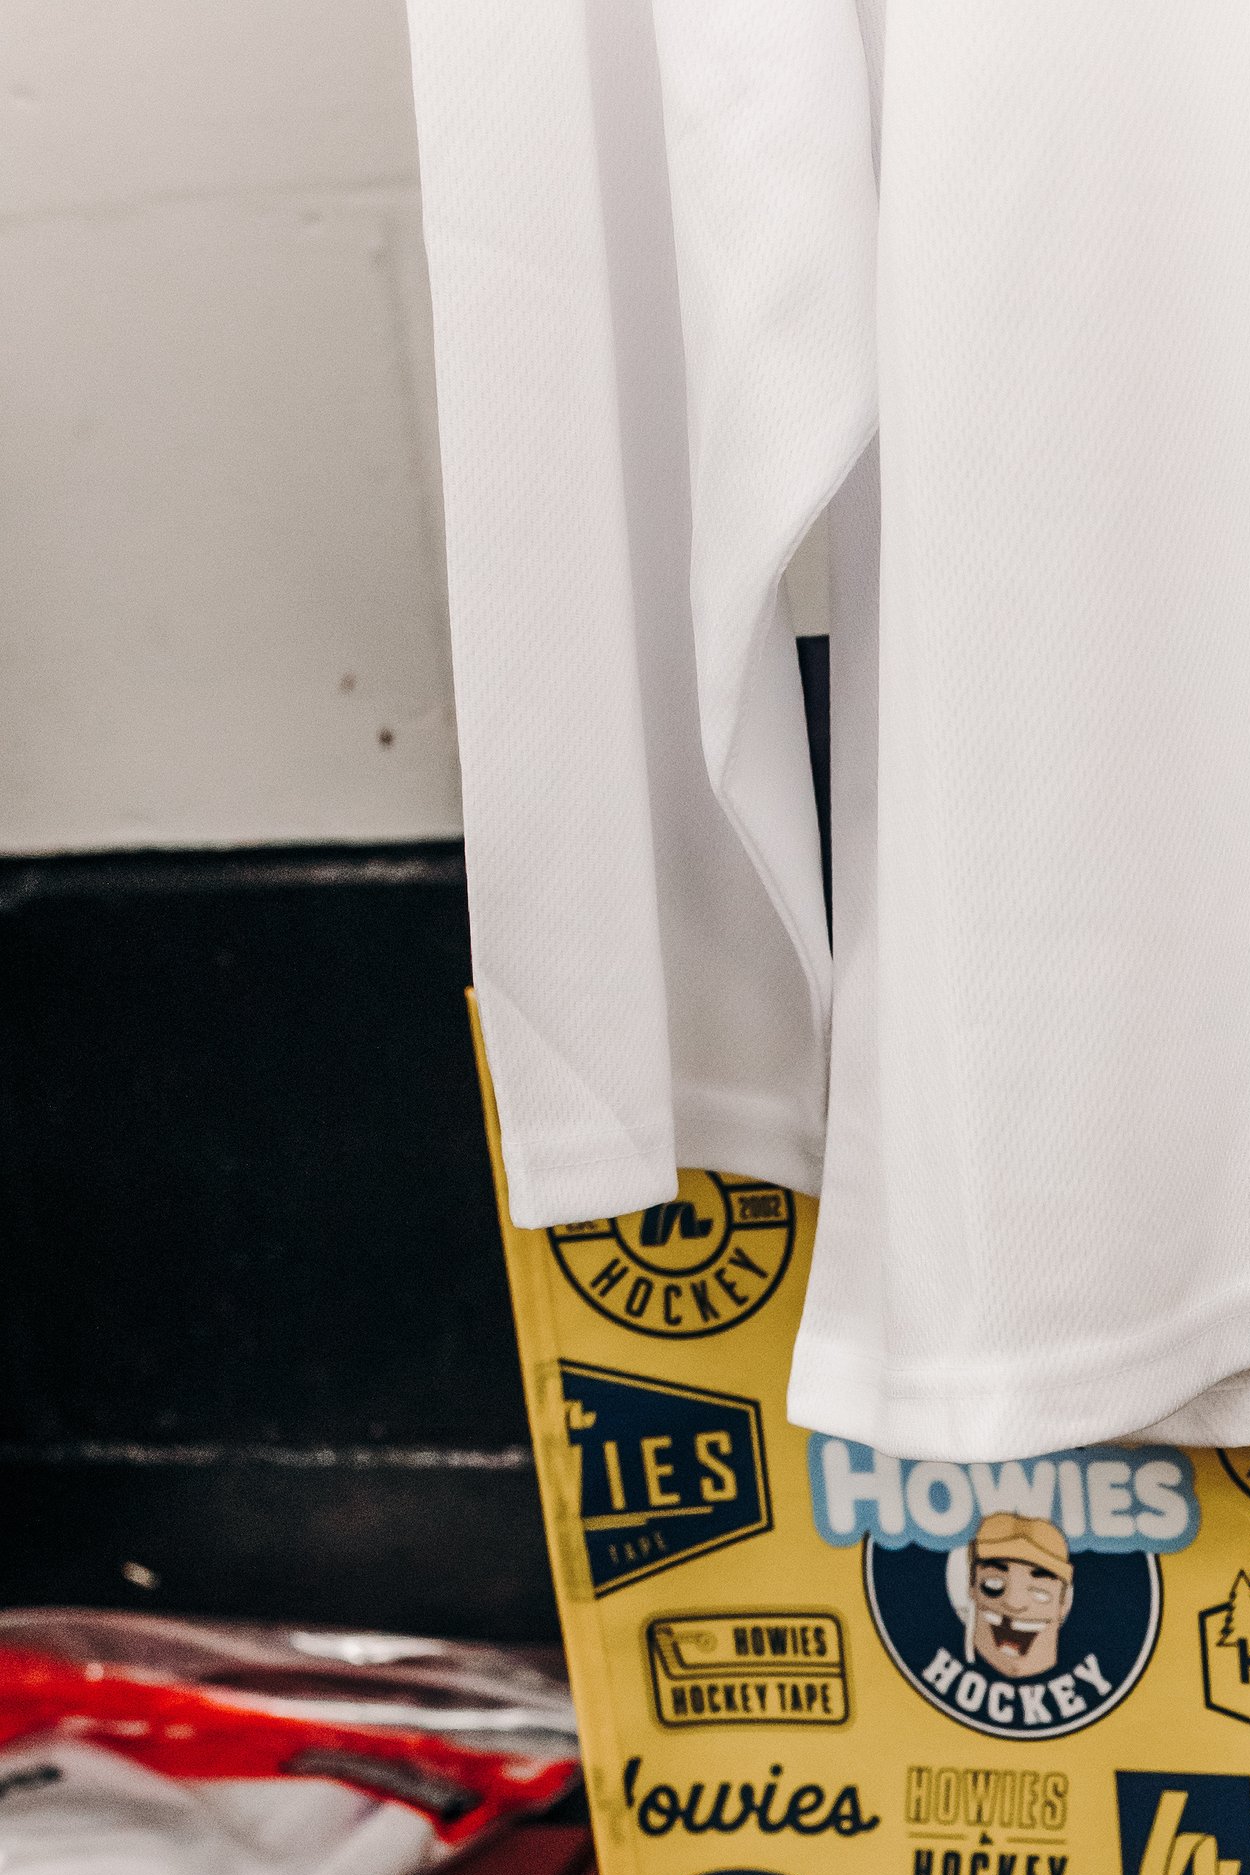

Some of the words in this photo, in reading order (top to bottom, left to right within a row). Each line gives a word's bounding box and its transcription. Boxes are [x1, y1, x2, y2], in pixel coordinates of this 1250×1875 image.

[590, 1247, 768, 1326] HOCKEY
[602, 1430, 737, 1510] IES
[821, 1439, 1190, 1540] HOWIES
[733, 1626, 827, 1656] HOWIES
[671, 1684, 767, 1715] HOCKEY
[777, 1683, 831, 1714] TAPE
[922, 1647, 1112, 1725] HOCKEY
[905, 1766, 1069, 1830] HOWIES
